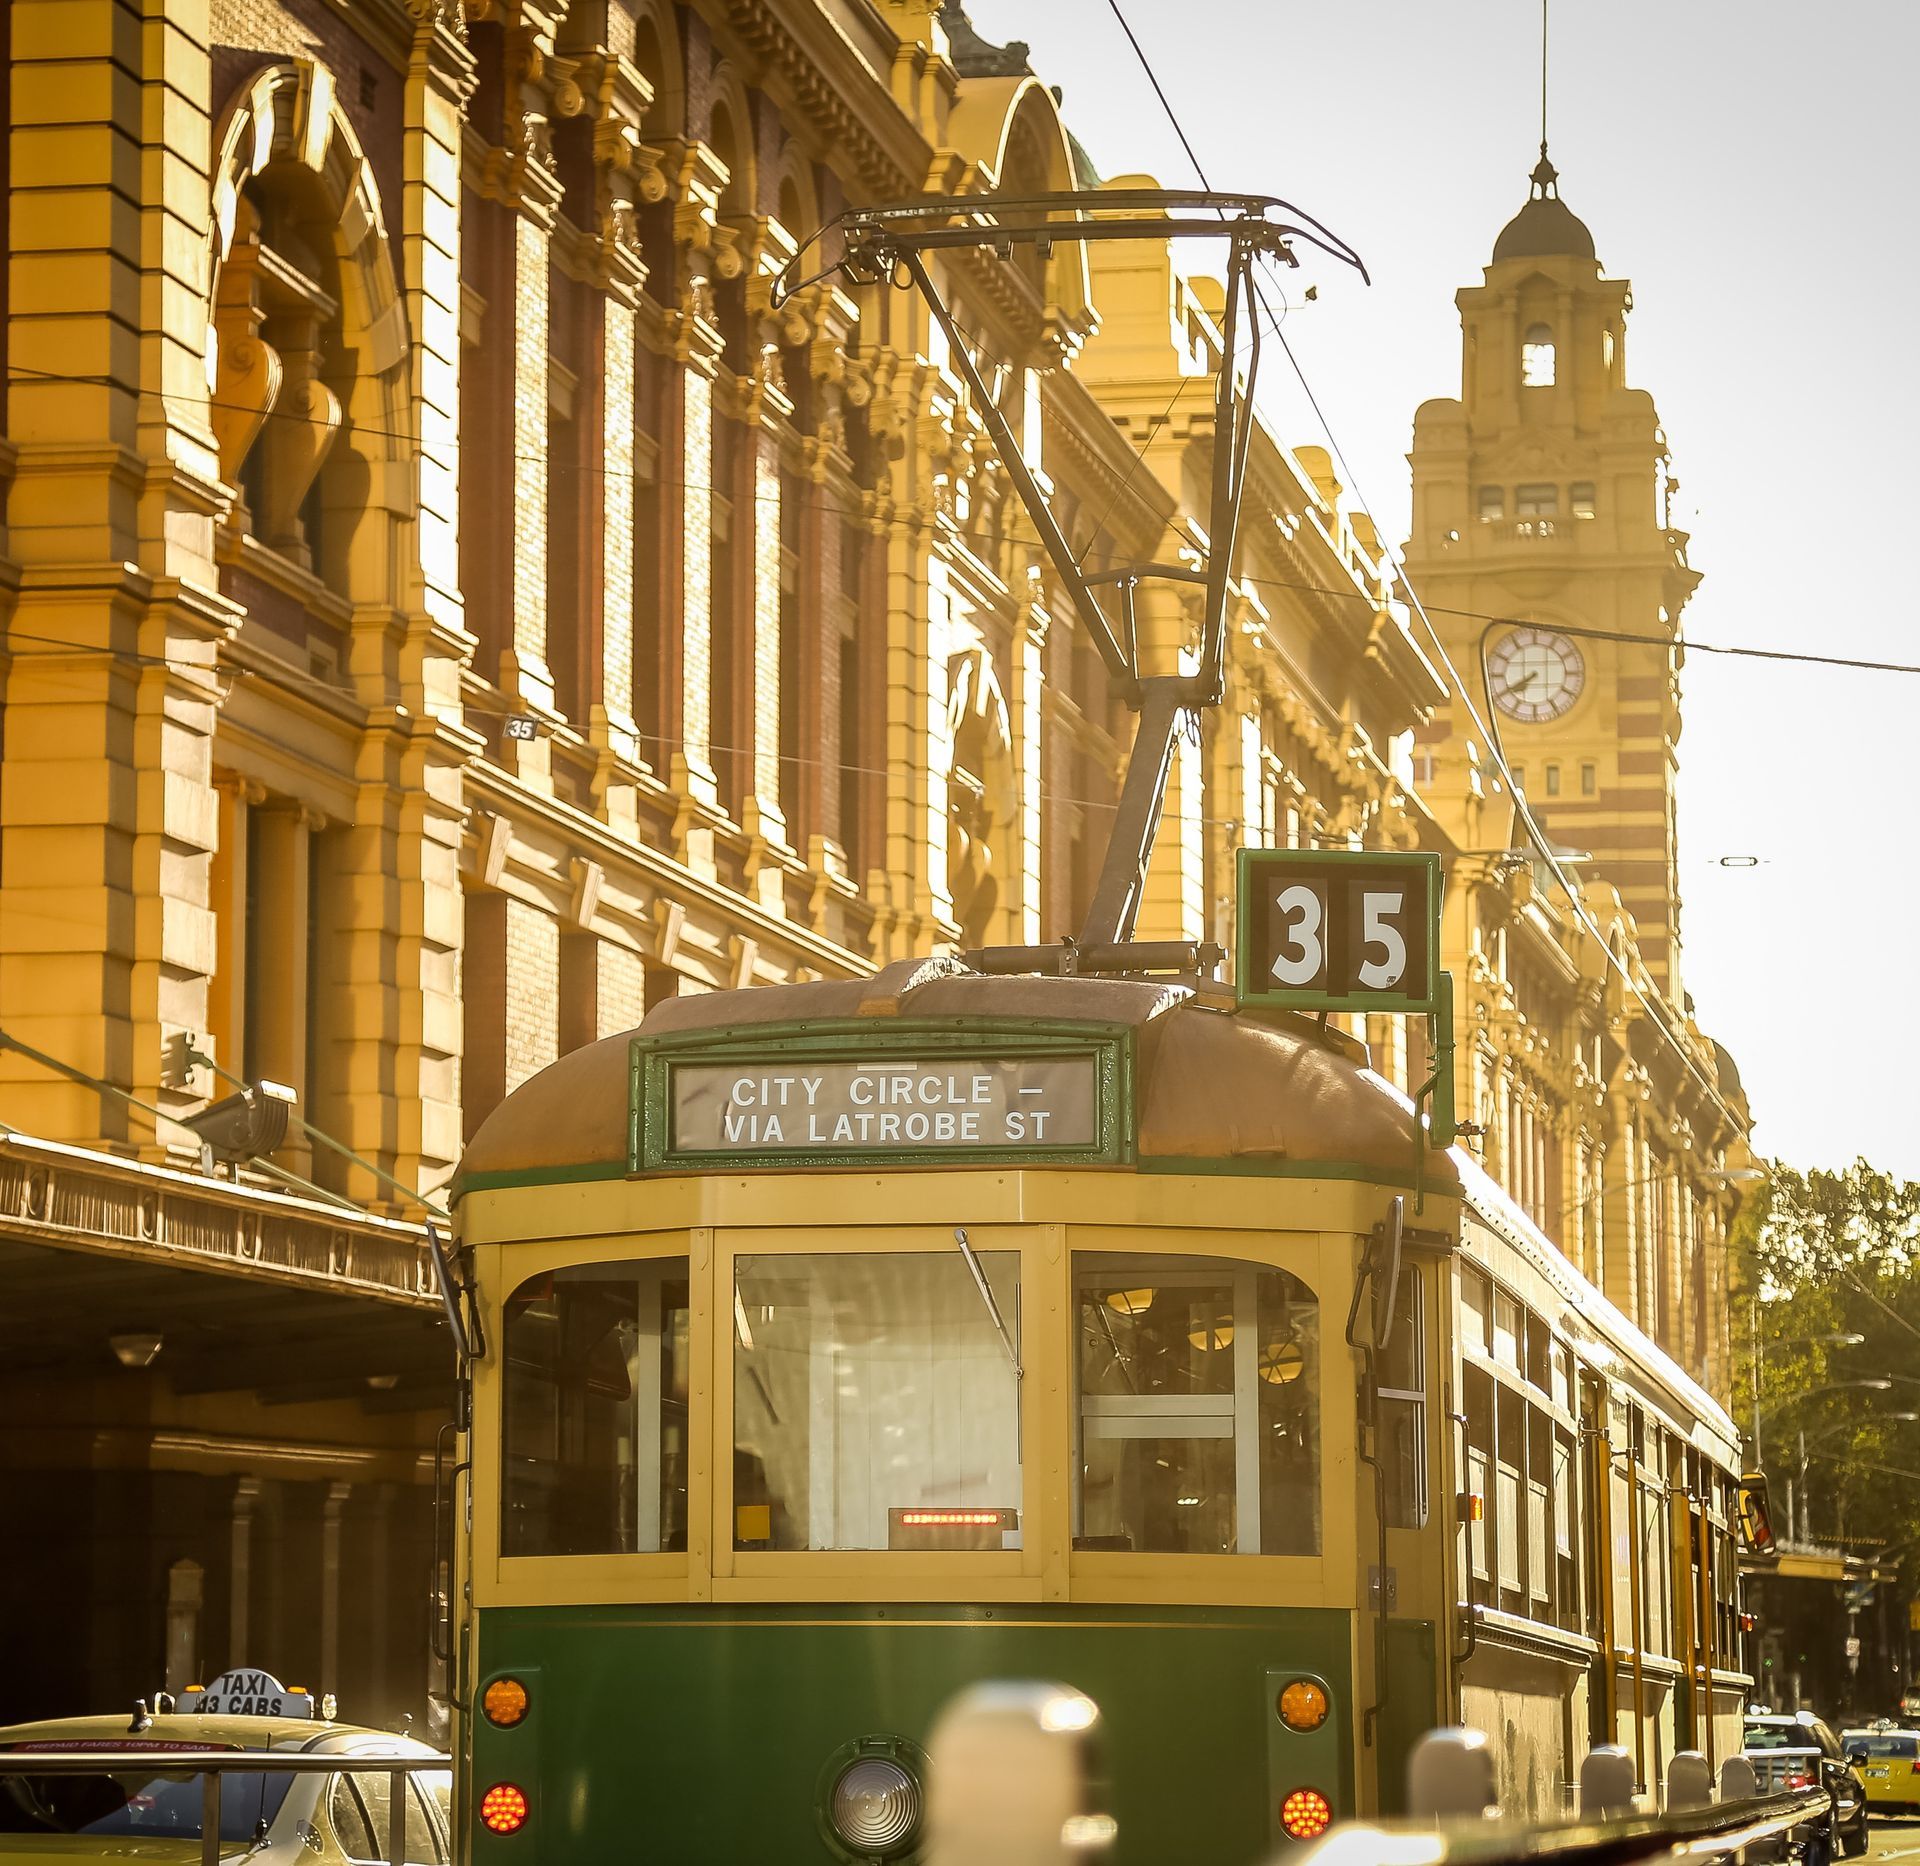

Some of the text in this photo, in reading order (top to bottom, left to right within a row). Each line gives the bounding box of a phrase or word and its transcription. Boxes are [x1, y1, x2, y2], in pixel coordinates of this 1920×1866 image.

[509, 720, 533, 739] 35
[1271, 885, 1407, 989] 35
[732, 1077, 823, 1106] CITY
[850, 1075, 992, 1105] CIRCLE
[724, 1111, 1051, 1142] VIA LATROBE ST
[221, 1674, 267, 1695] TAXI
[199, 1695, 282, 1716] 13 CABS
[26, 1742, 80, 1750] PREPAID
[126, 1741, 160, 1749] 10PM
